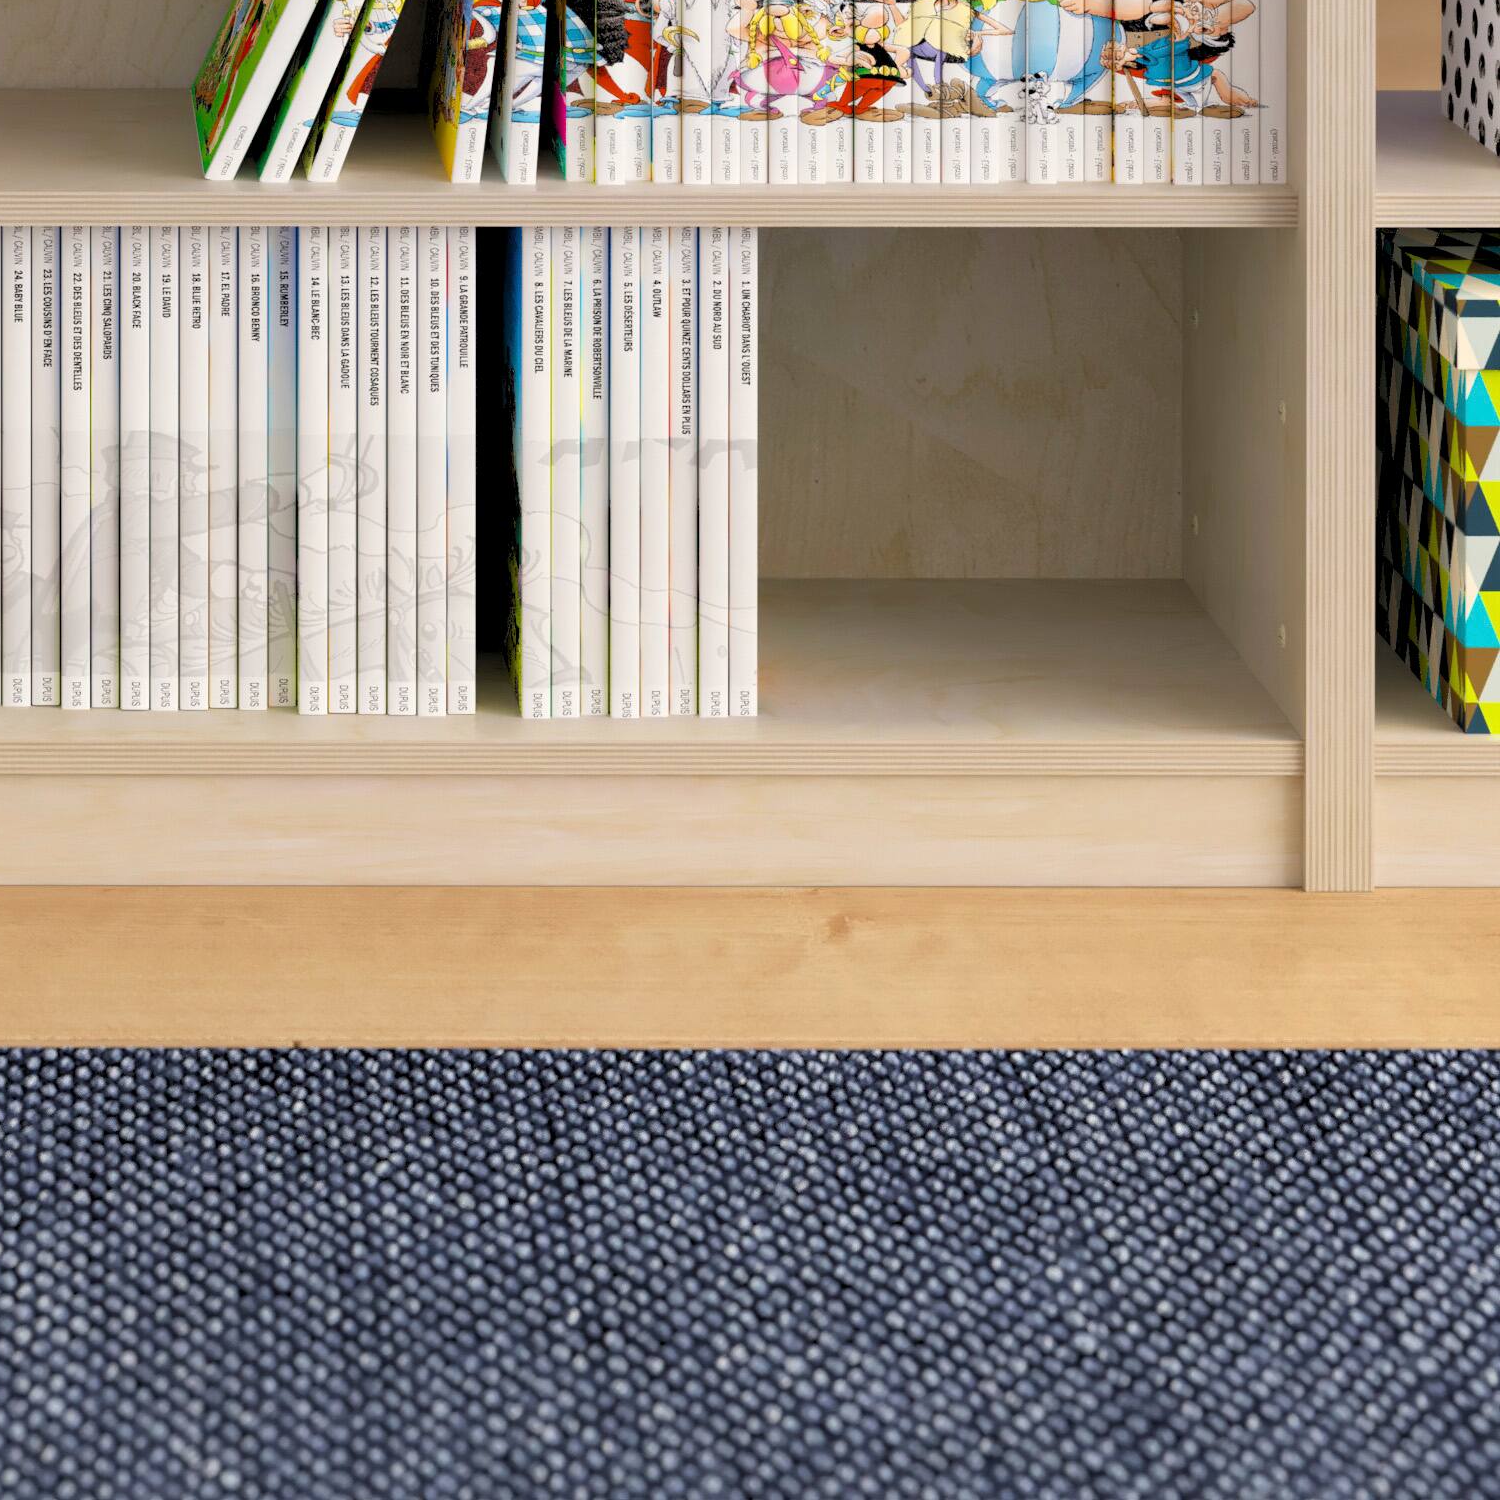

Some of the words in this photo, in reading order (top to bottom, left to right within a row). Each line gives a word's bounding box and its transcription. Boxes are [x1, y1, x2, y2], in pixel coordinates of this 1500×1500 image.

[132, 272, 141, 284] 20.
[251, 274, 260, 284] 16.
[279, 271, 288, 281] 15.
[133, 286, 141, 309] BLACK
[460, 285, 468, 293] LA
[593, 288, 602, 296] LA
[742, 289, 750, 299] UN
[251, 286, 260, 316] BRONCO
[280, 284, 289, 327] RUMBERLEY
[459, 295, 468, 324] GRANDE
[593, 298, 602, 325] PRISON
[653, 289, 661, 317] OUTLAW
[132, 311, 141, 328] FACE
[742, 301, 750, 332] CHARIOT
[252, 318, 260, 341] BENNY
[593, 327, 602, 336] DE
[460, 326, 468, 368] PATROUILLE
[742, 334, 750, 353] DANS
[593, 338, 602, 399] ROBERTSONVILLE
[740, 691, 749, 715] DUPUIS
